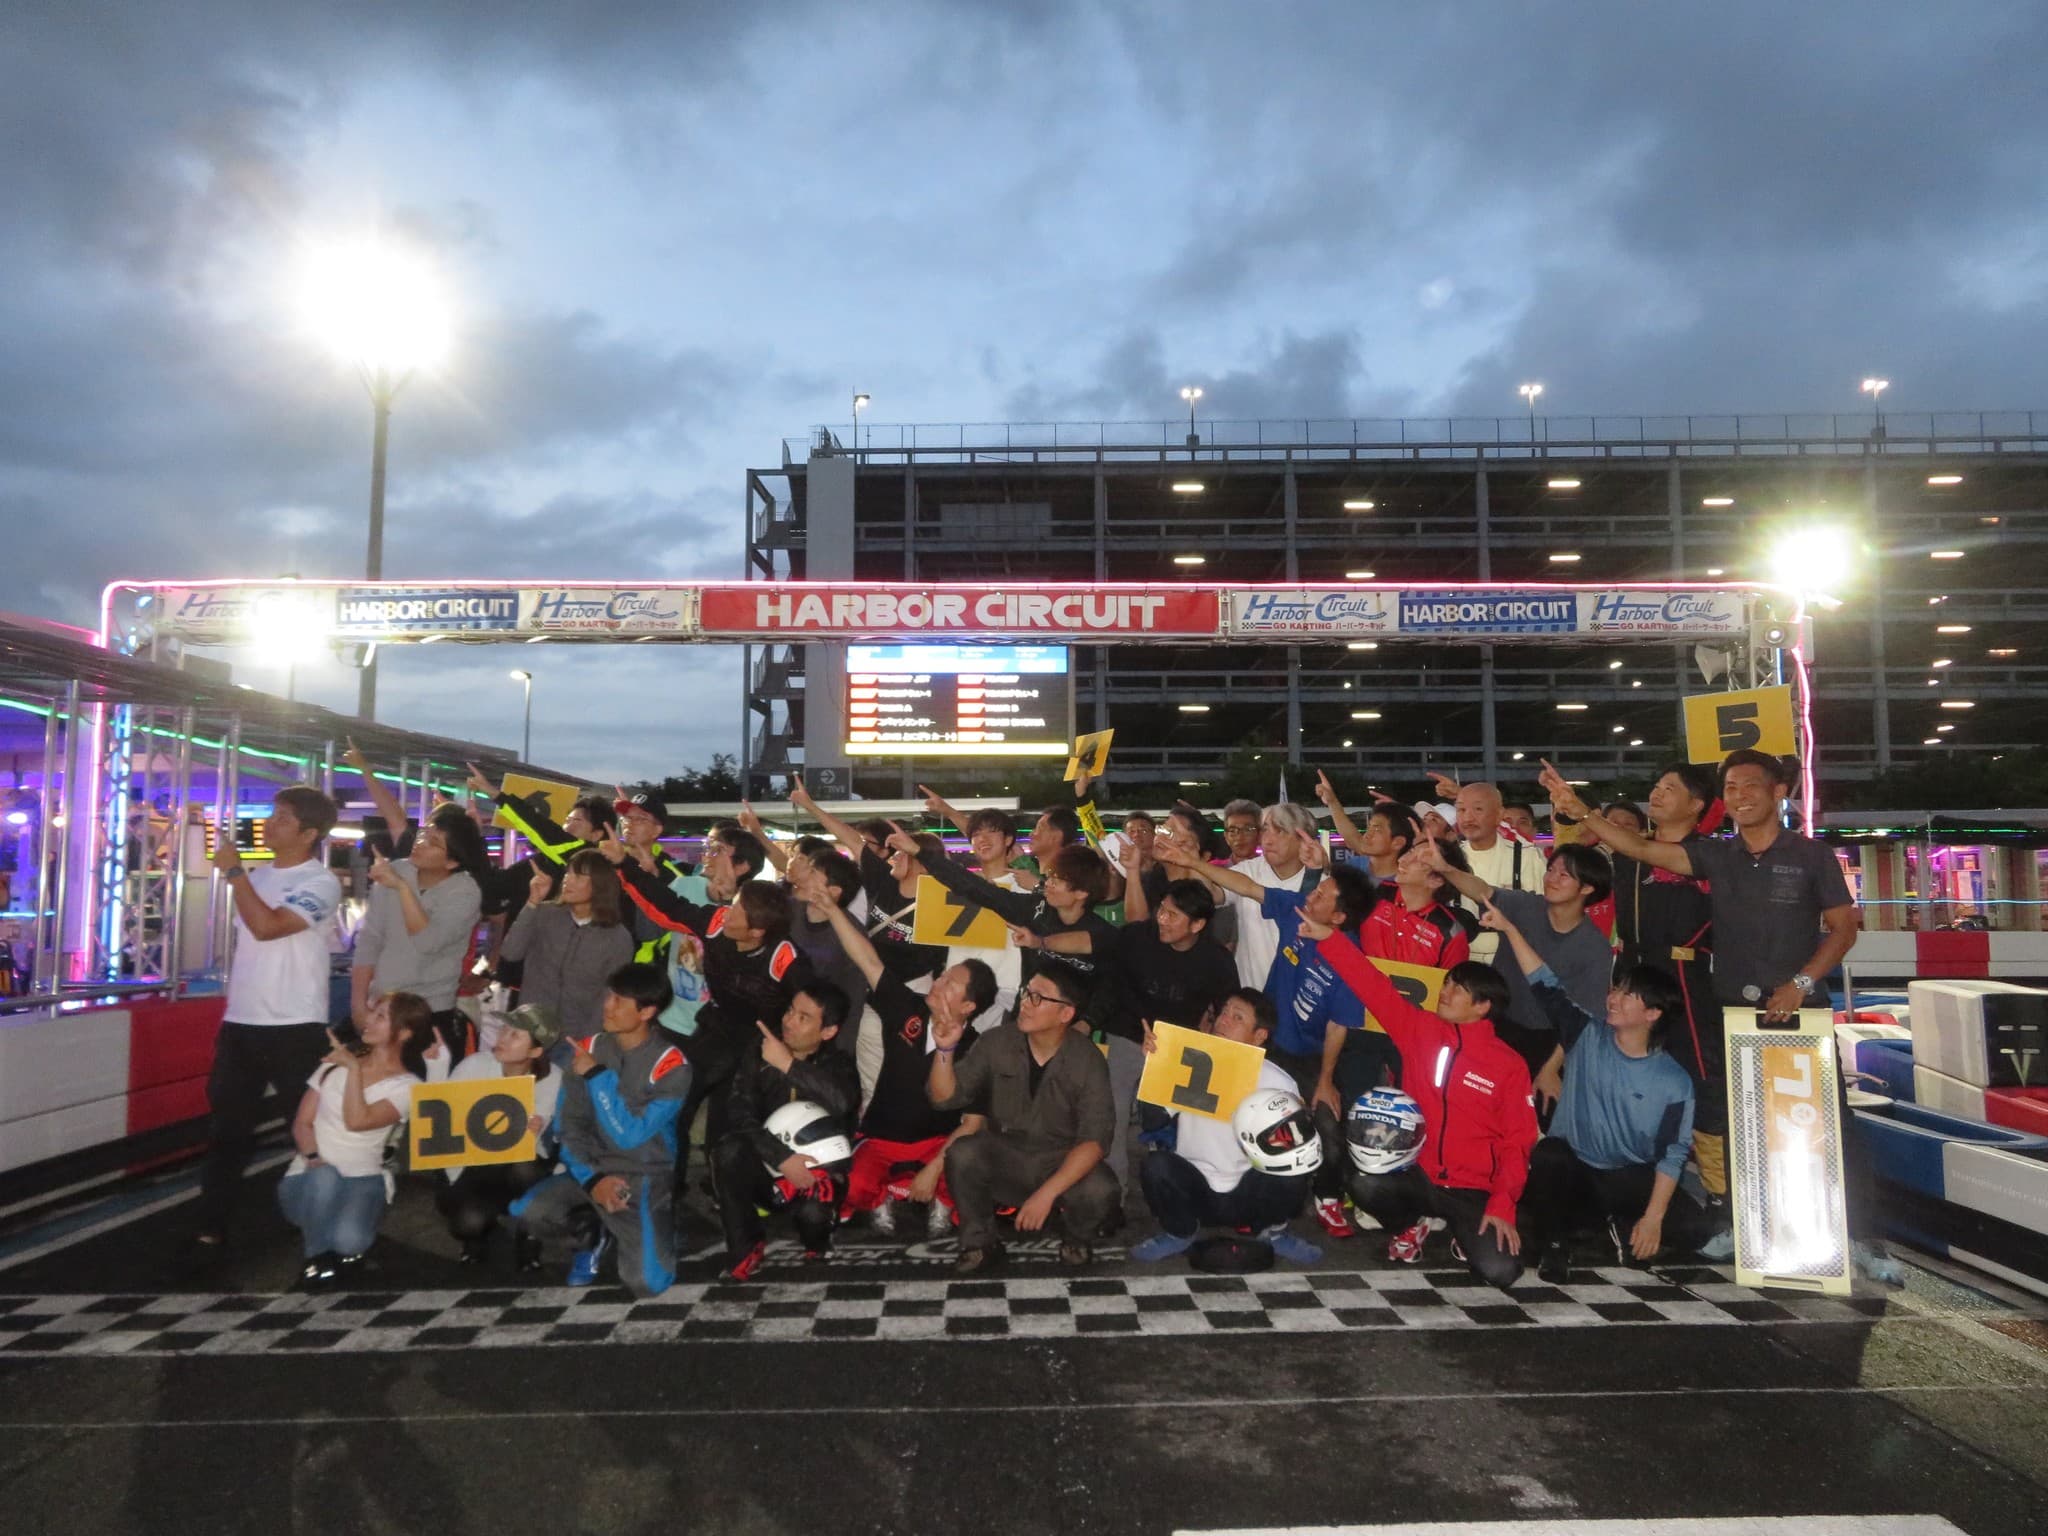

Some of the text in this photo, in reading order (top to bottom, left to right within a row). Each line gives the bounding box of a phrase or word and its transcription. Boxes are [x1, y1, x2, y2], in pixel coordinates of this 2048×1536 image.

[340, 600, 427, 621] HARBOR
[433, 598, 514, 618] CIRCUIT
[532, 592, 661, 619] Harbor Circuit
[755, 594, 1166, 629] HARBOR CIRCUIT
[1243, 594, 1369, 621] Harbor Circuit
[1403, 603, 1488, 624] HARBOR
[1495, 601, 1571, 621] CIRCUIT
[1591, 594, 1715, 622] Harbor Circuit
[562, 620, 622, 629] GO KARTING
[1273, 622, 1332, 630] GO KARTING
[1637, 623, 1679, 631] KARTING
[1716, 702, 1760, 751] 5
[944, 891, 982, 936] 7
[1171, 1046, 1219, 1114] 1
[418, 1093, 528, 1157] 10
[1357, 1112, 1397, 1126] HONDA
